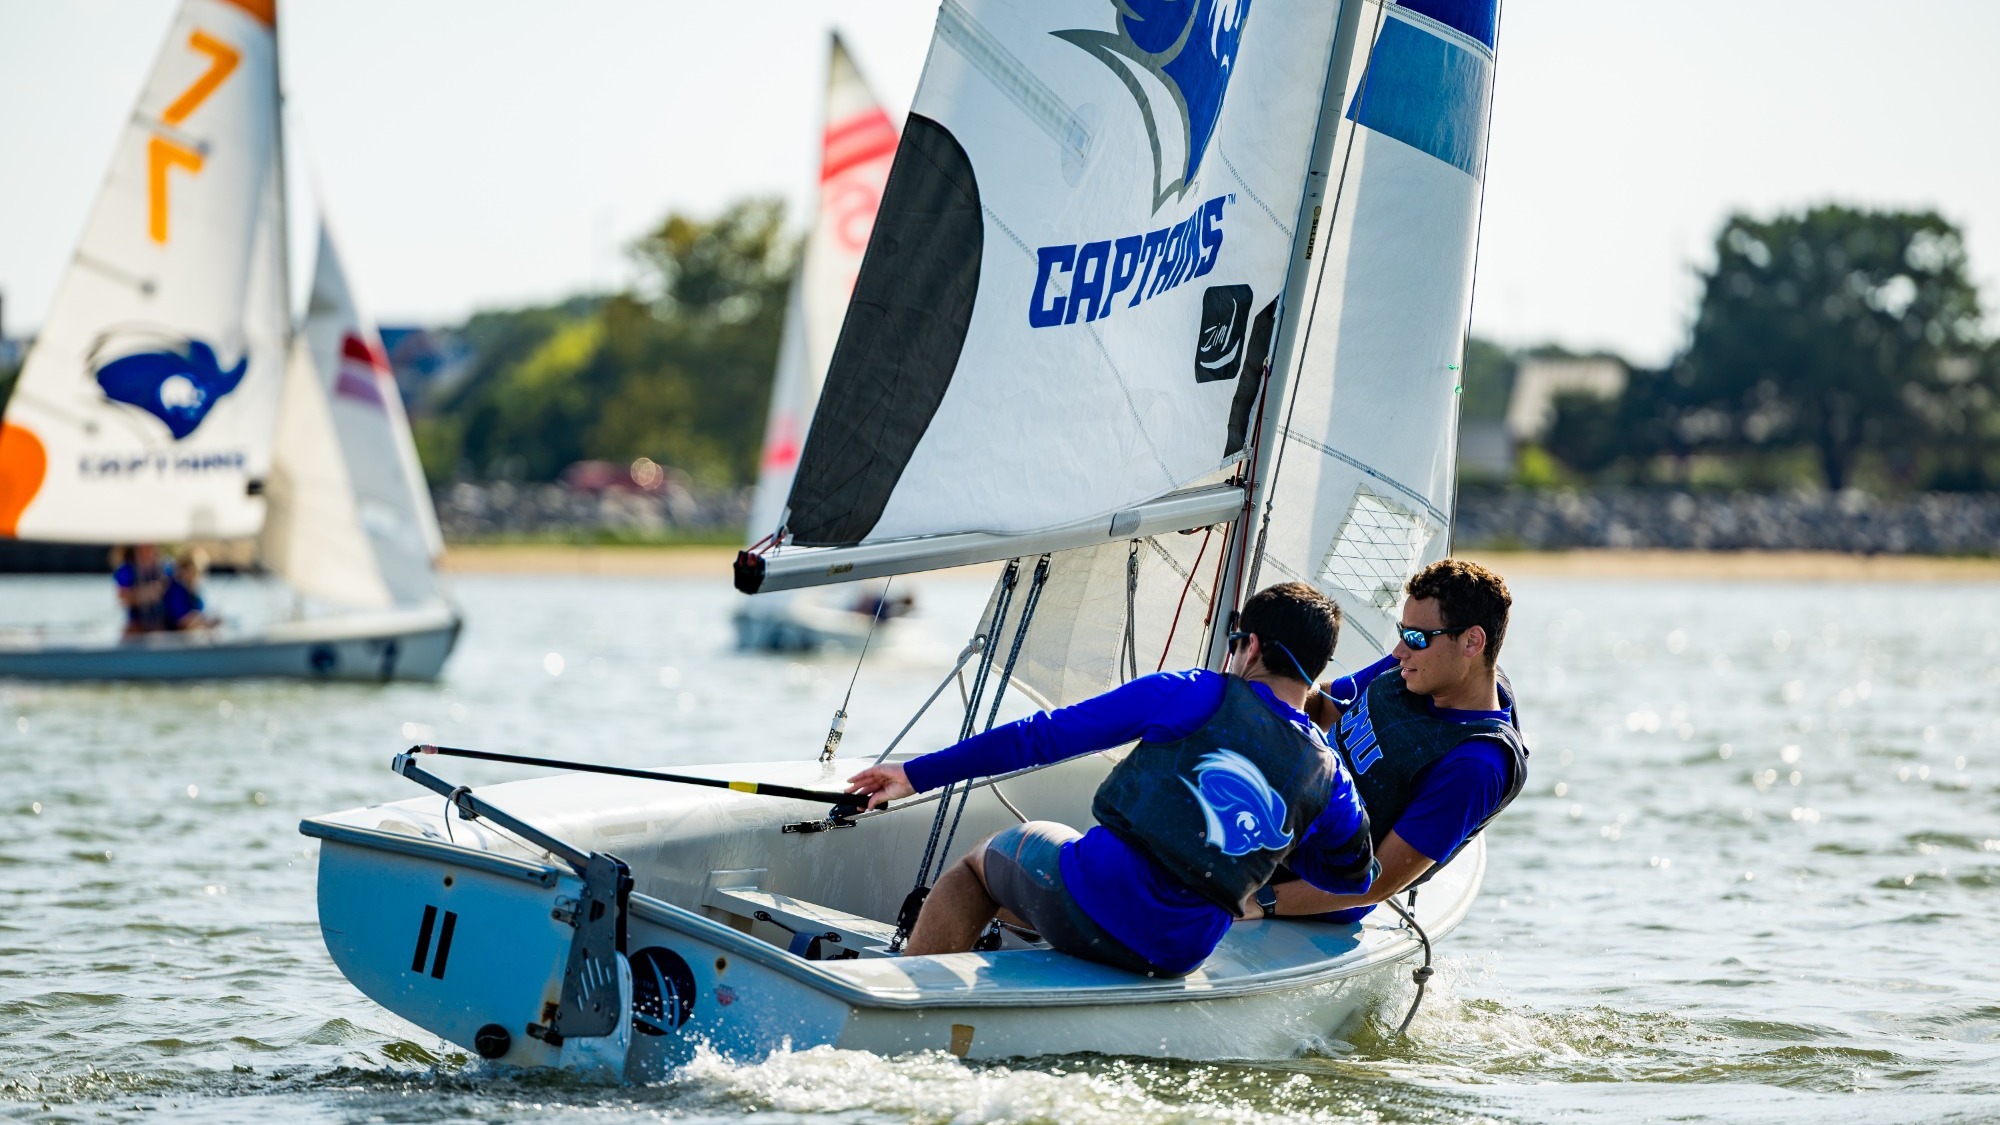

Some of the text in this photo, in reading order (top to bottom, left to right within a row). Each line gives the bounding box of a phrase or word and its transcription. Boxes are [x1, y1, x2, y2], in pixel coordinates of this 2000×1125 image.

[161, 30, 242, 126] 7
[1028, 195, 1226, 328] CAPTAINS
[411, 904, 458, 980] 11
